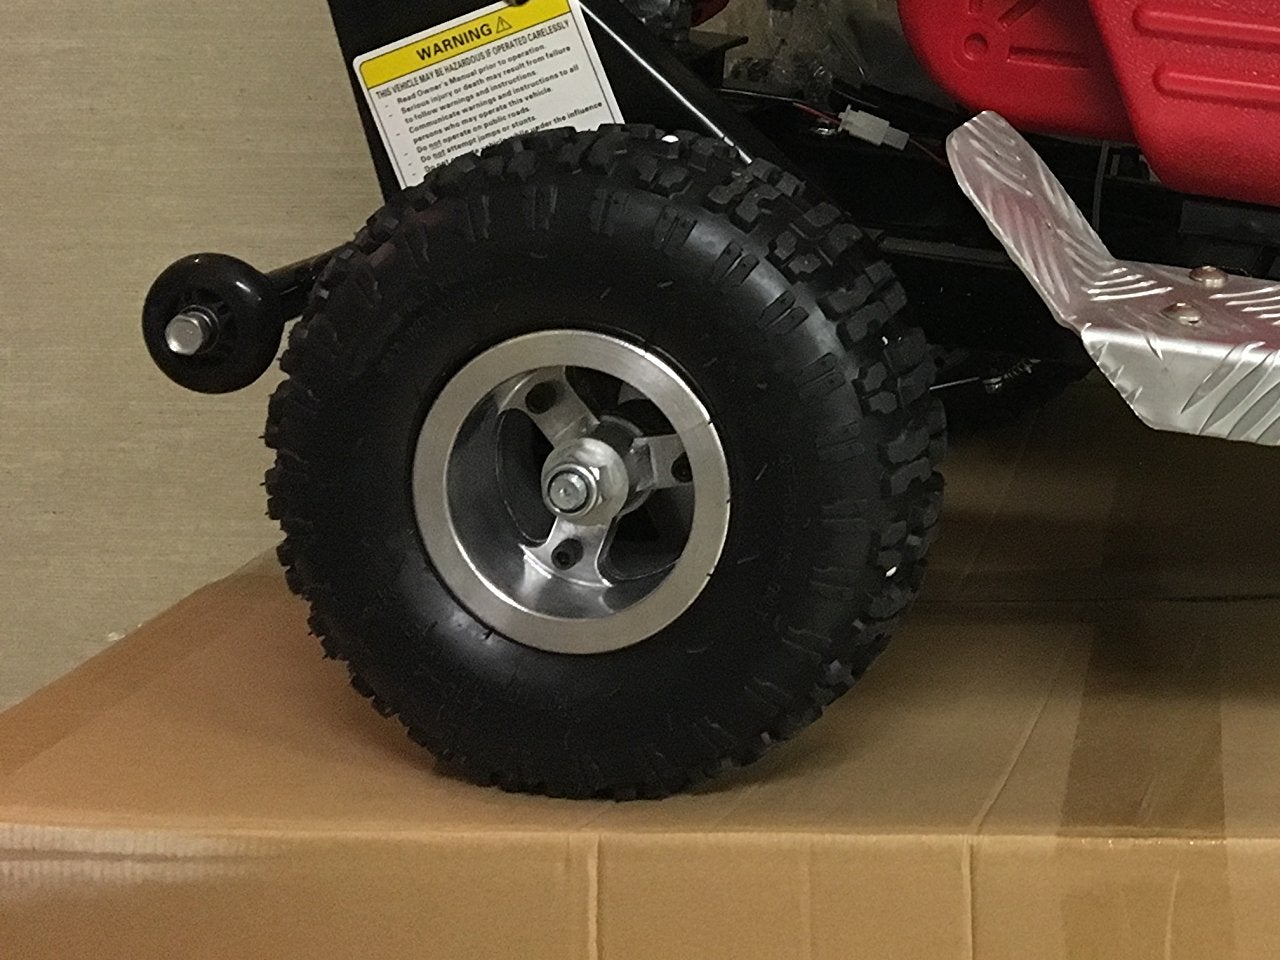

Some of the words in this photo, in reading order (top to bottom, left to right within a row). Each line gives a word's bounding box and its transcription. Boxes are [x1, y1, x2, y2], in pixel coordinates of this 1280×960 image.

[375, 87, 391, 99] THIS
[391, 76, 419, 93] VEHICLE
[418, 70, 435, 83] MAY
[434, 67, 444, 77] BE
[443, 51, 486, 73] HAZARDOUS
[484, 48, 492, 58] IF
[491, 35, 527, 55] OPERATED
[526, 19, 570, 42] CARELESSLY
[415, 22, 492, 61] WARNING
[396, 91, 416, 104] Read
[416, 79, 448, 96] Owner's
[448, 68, 477, 84] Manual
[477, 61, 497, 74] prior
[497, 58, 506, 66] to
[400, 97, 429, 114] Serious
[429, 89, 453, 104] injury
[462, 77, 484, 90] death
[485, 71, 502, 82] may
[502, 61, 525, 75] result
[525, 54, 545, 66] from
[544, 44, 570, 59] failure
[408, 108, 460, 133] Communicate
[460, 95, 496, 114] warnings
[497, 89, 512, 100] and
[512, 71, 558, 94] instructions
[559, 68, 568, 76] to
[568, 63, 579, 72] all
[404, 115, 413, 123] to
[413, 106, 438, 120] follow
[438, 92, 474, 112] warnings
[474, 86, 489, 97] and
[412, 128, 443, 144] persons
[443, 120, 460, 131] who
[460, 115, 477, 126] may
[478, 102, 507, 119] operate
[508, 96, 523, 107] this
[552, 113, 566, 124] the
[566, 100, 602, 118] influence
[415, 143, 428, 153] Do
[428, 139, 441, 148] not
[441, 127, 472, 144] operate
[472, 124, 482, 132] on
[482, 113, 507, 128] public
[419, 153, 431, 163] Do
[432, 148, 445, 158] not
[446, 137, 477, 154] attempt
[476, 127, 501, 142] jumps
